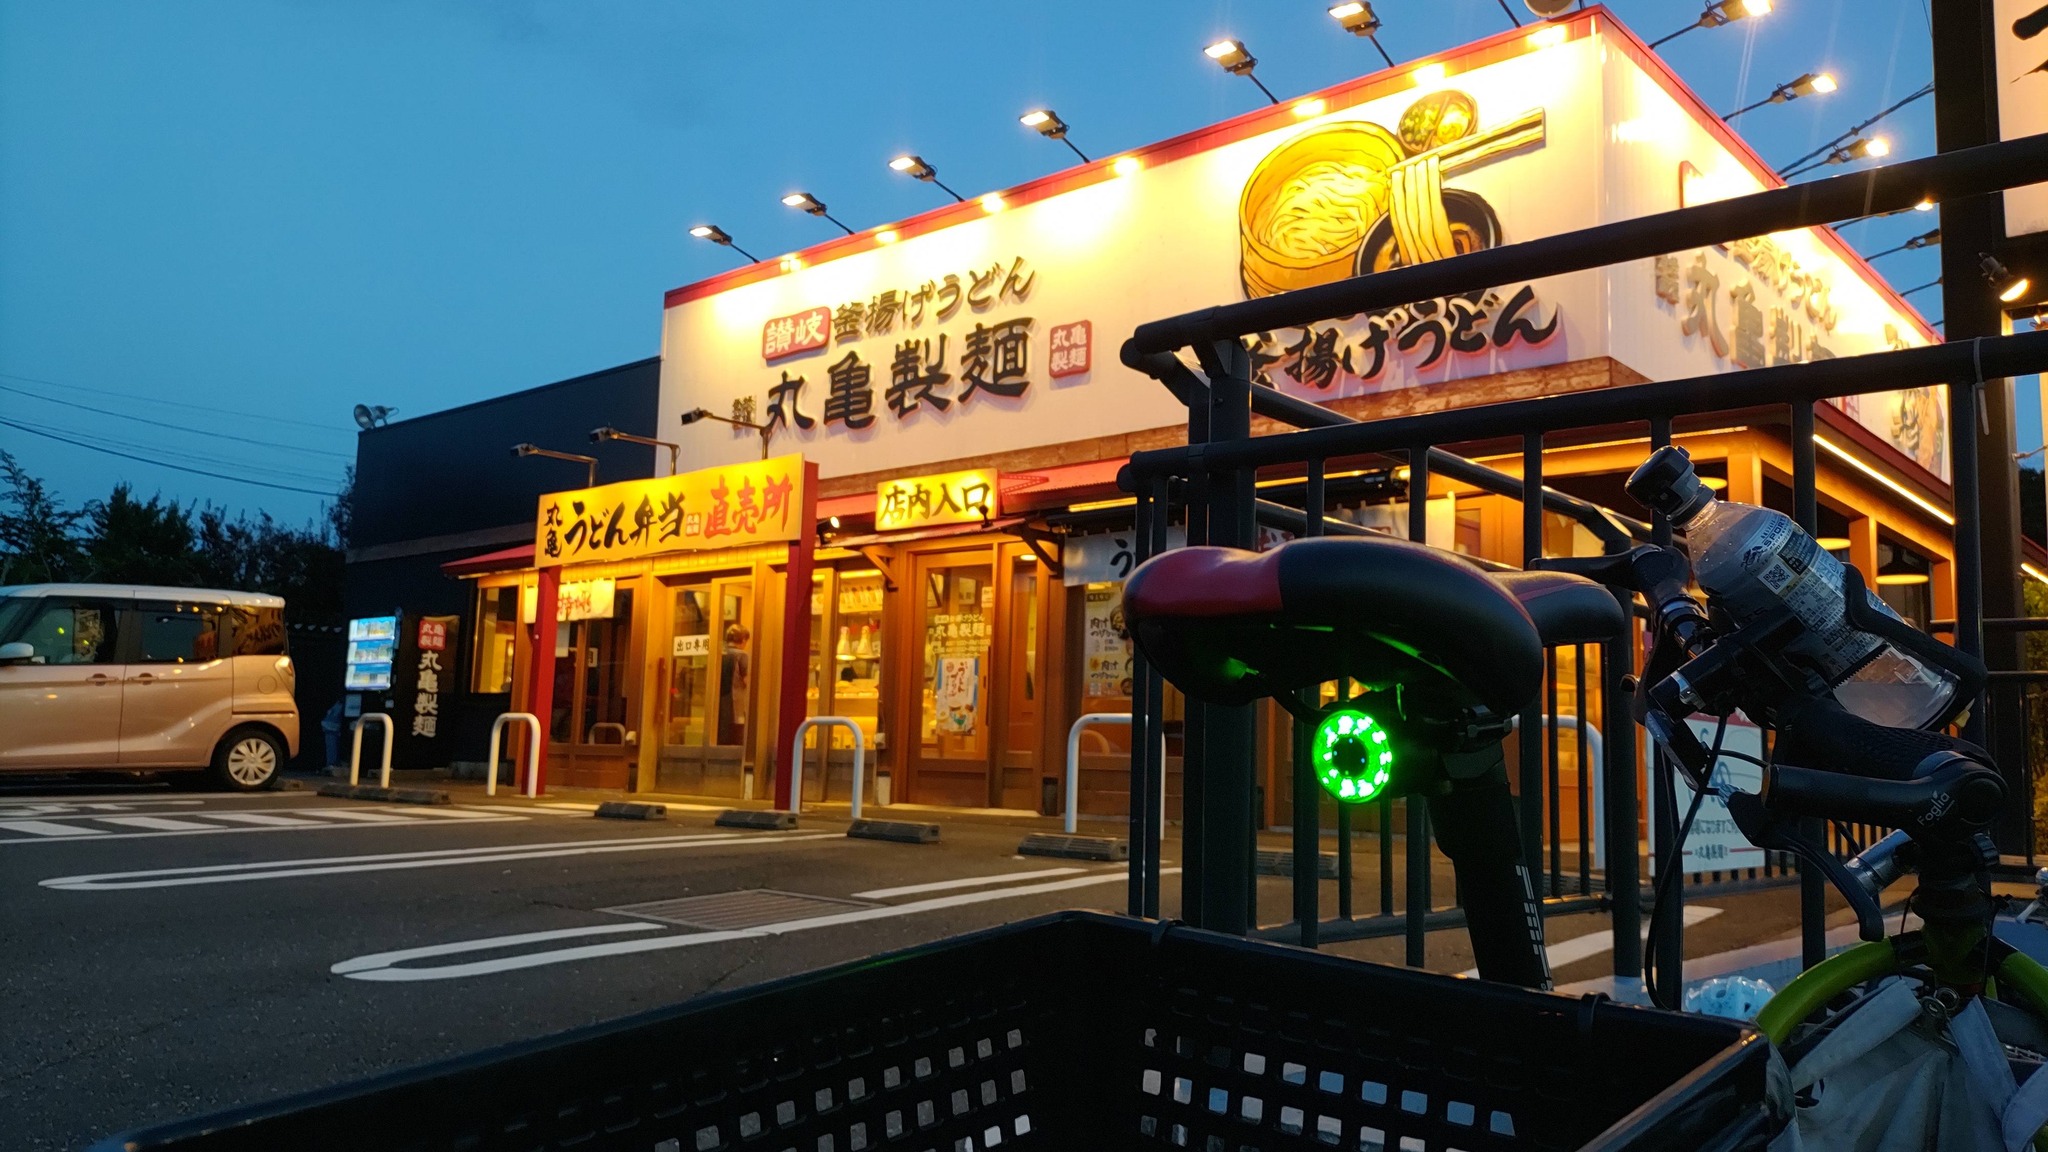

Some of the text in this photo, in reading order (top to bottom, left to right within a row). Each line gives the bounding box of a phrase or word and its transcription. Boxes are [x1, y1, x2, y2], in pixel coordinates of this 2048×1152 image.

[832, 256, 1034, 343] 釜揚げうどん
[765, 311, 826, 354] 讃岐
[767, 317, 1035, 430] 丸亀製麺
[544, 501, 562, 558] 丸亀
[564, 492, 685, 556] うどん弁当
[704, 474, 794, 540] 直売所
[879, 481, 992, 524] 店内入口
[676, 638, 709, 652] 出口専用
[411, 650, 443, 738] 丸亀製麺
[1917, 792, 1950, 826] Foglia
